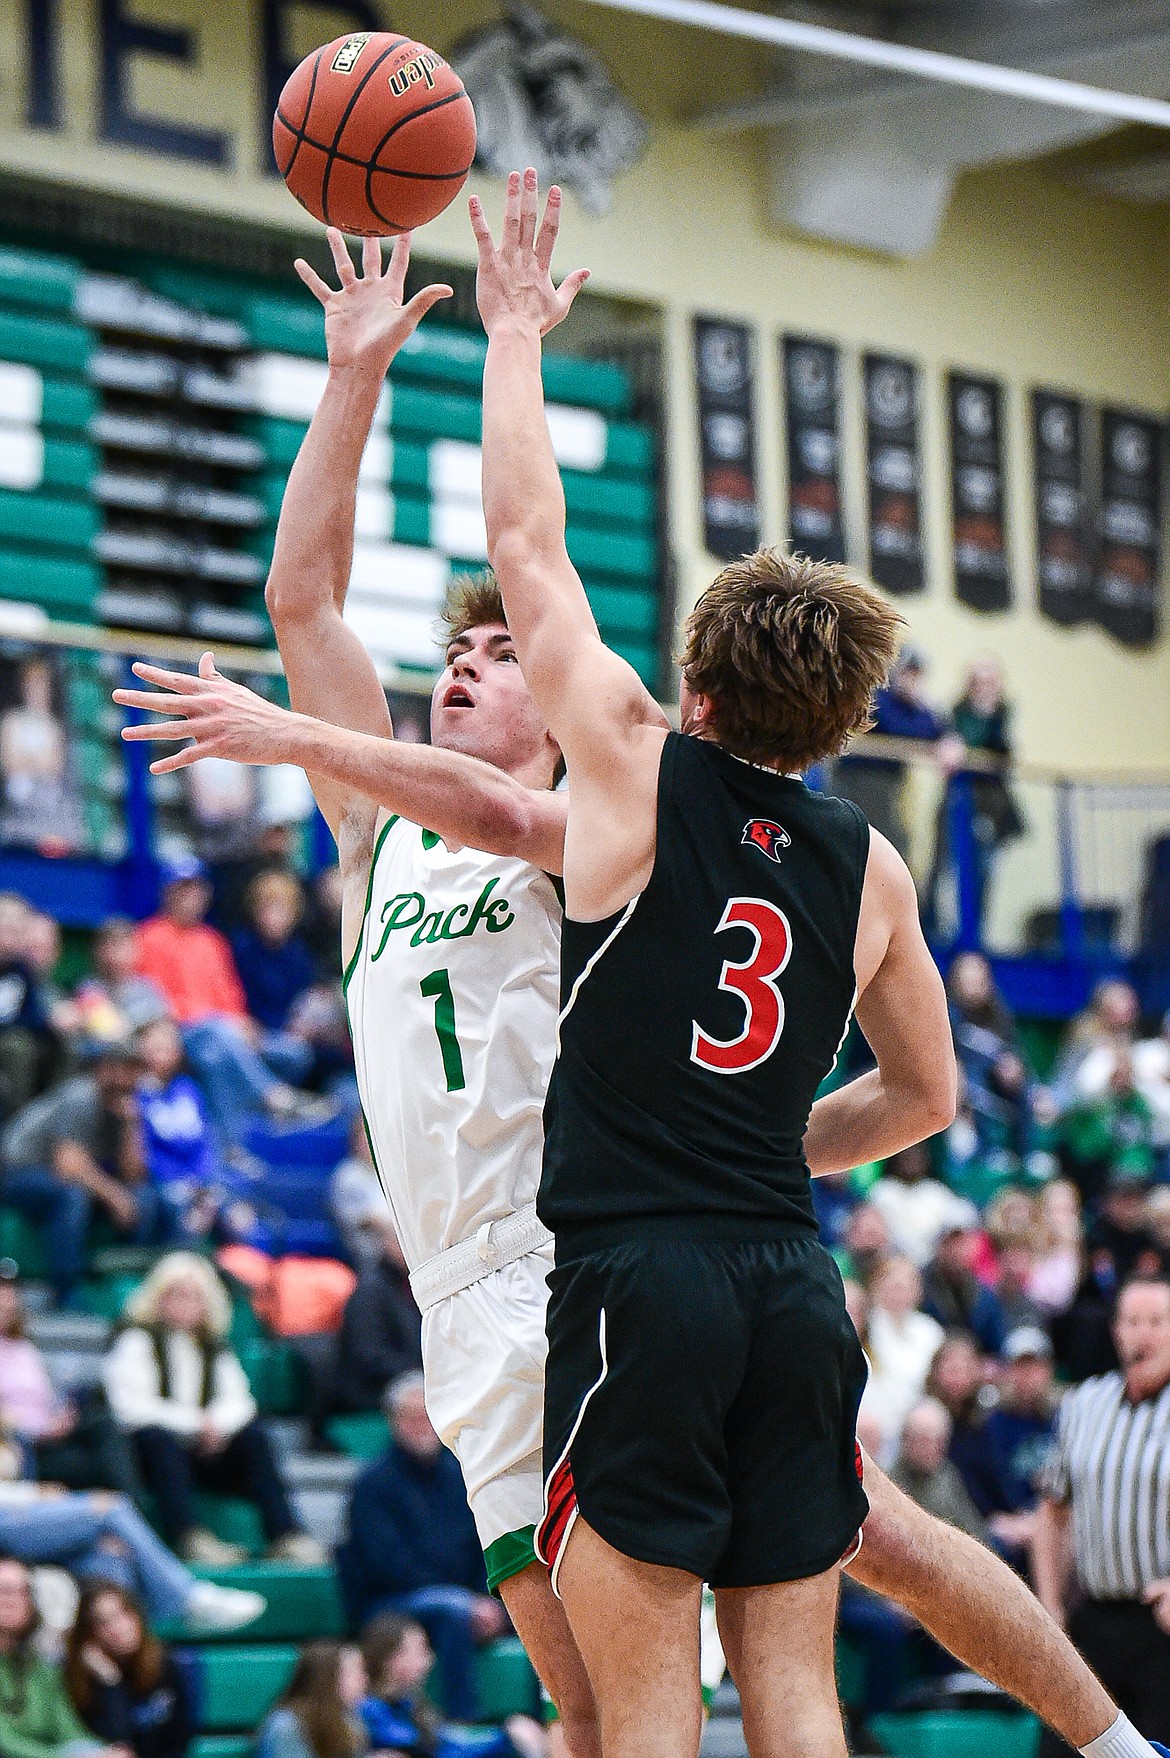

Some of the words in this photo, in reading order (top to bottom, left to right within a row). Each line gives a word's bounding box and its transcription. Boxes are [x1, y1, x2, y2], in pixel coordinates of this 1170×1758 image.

[371, 877, 515, 962] Pack
[420, 969, 466, 1093] 1
[690, 897, 793, 1074] 3
